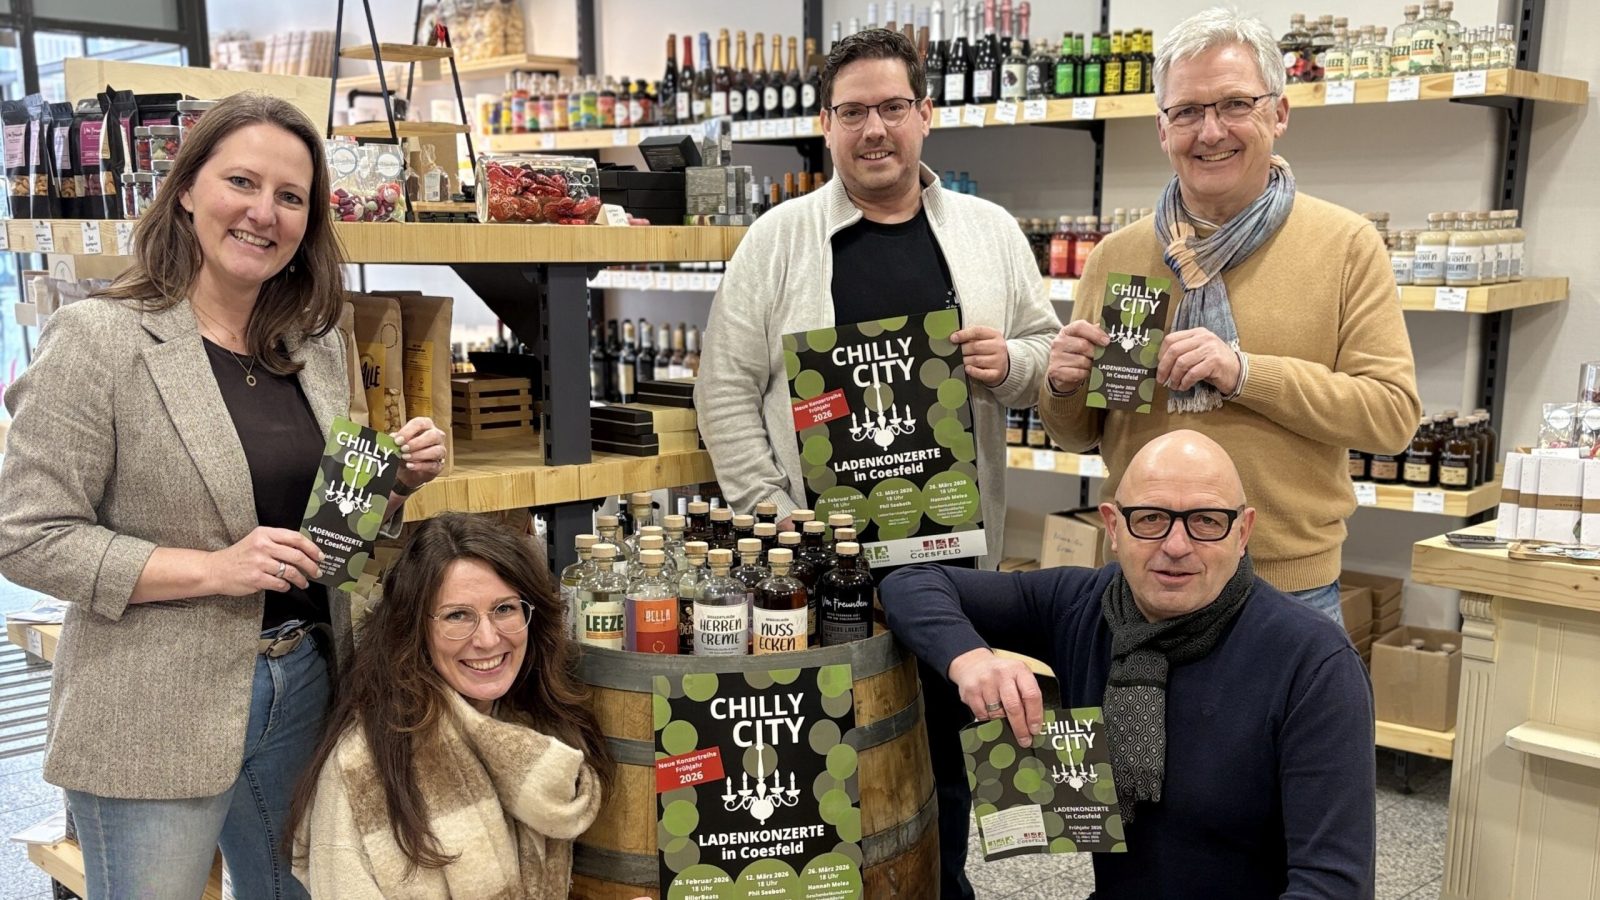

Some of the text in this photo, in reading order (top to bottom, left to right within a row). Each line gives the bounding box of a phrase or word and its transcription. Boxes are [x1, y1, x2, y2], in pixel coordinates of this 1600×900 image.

[1111, 283, 1163, 300] CHILLY
[1120, 297, 1161, 315] CITY
[831, 336, 913, 366] CHILLY
[852, 356, 915, 388] CITY
[1098, 364, 1149, 375] LADENKONZERTE
[1113, 372, 1139, 380] Coesfeld
[812, 410, 833, 423] 2026
[336, 431, 394, 461] CHILLY
[344, 450, 390, 478] CITY
[833, 447, 941, 473] LADENKONZERTE
[854, 461, 924, 482] in Coesfeld
[308, 525, 364, 548] LADENKONZERTE
[316, 536, 352, 553] in Coesfeld
[910, 548, 961, 560] COESFELD
[833, 593, 868, 611] Freunden
[585, 614, 624, 632] LEEZE
[645, 608, 671, 623] BELLA
[700, 618, 742, 632] HERREN
[761, 622, 794, 637] NUSS
[701, 632, 740, 646] CREME
[759, 637, 796, 651] ECKEN
[709, 692, 804, 720] CHILLY
[732, 716, 806, 748] CITY
[1051, 732, 1096, 750] CITY
[658, 751, 717, 769] Neue Konzertreihe
[675, 762, 703, 773] Frühjahr
[679, 770, 704, 784] 2026
[1053, 805, 1110, 813] LADENKONZERTE
[699, 824, 825, 847] LADENKONZERTE
[721, 841, 804, 860] in Coesfeld
[685, 877, 713, 885] Februar
[756, 872, 773, 880] März
[773, 871, 789, 879] 2026
[807, 883, 831, 891] Hannah
